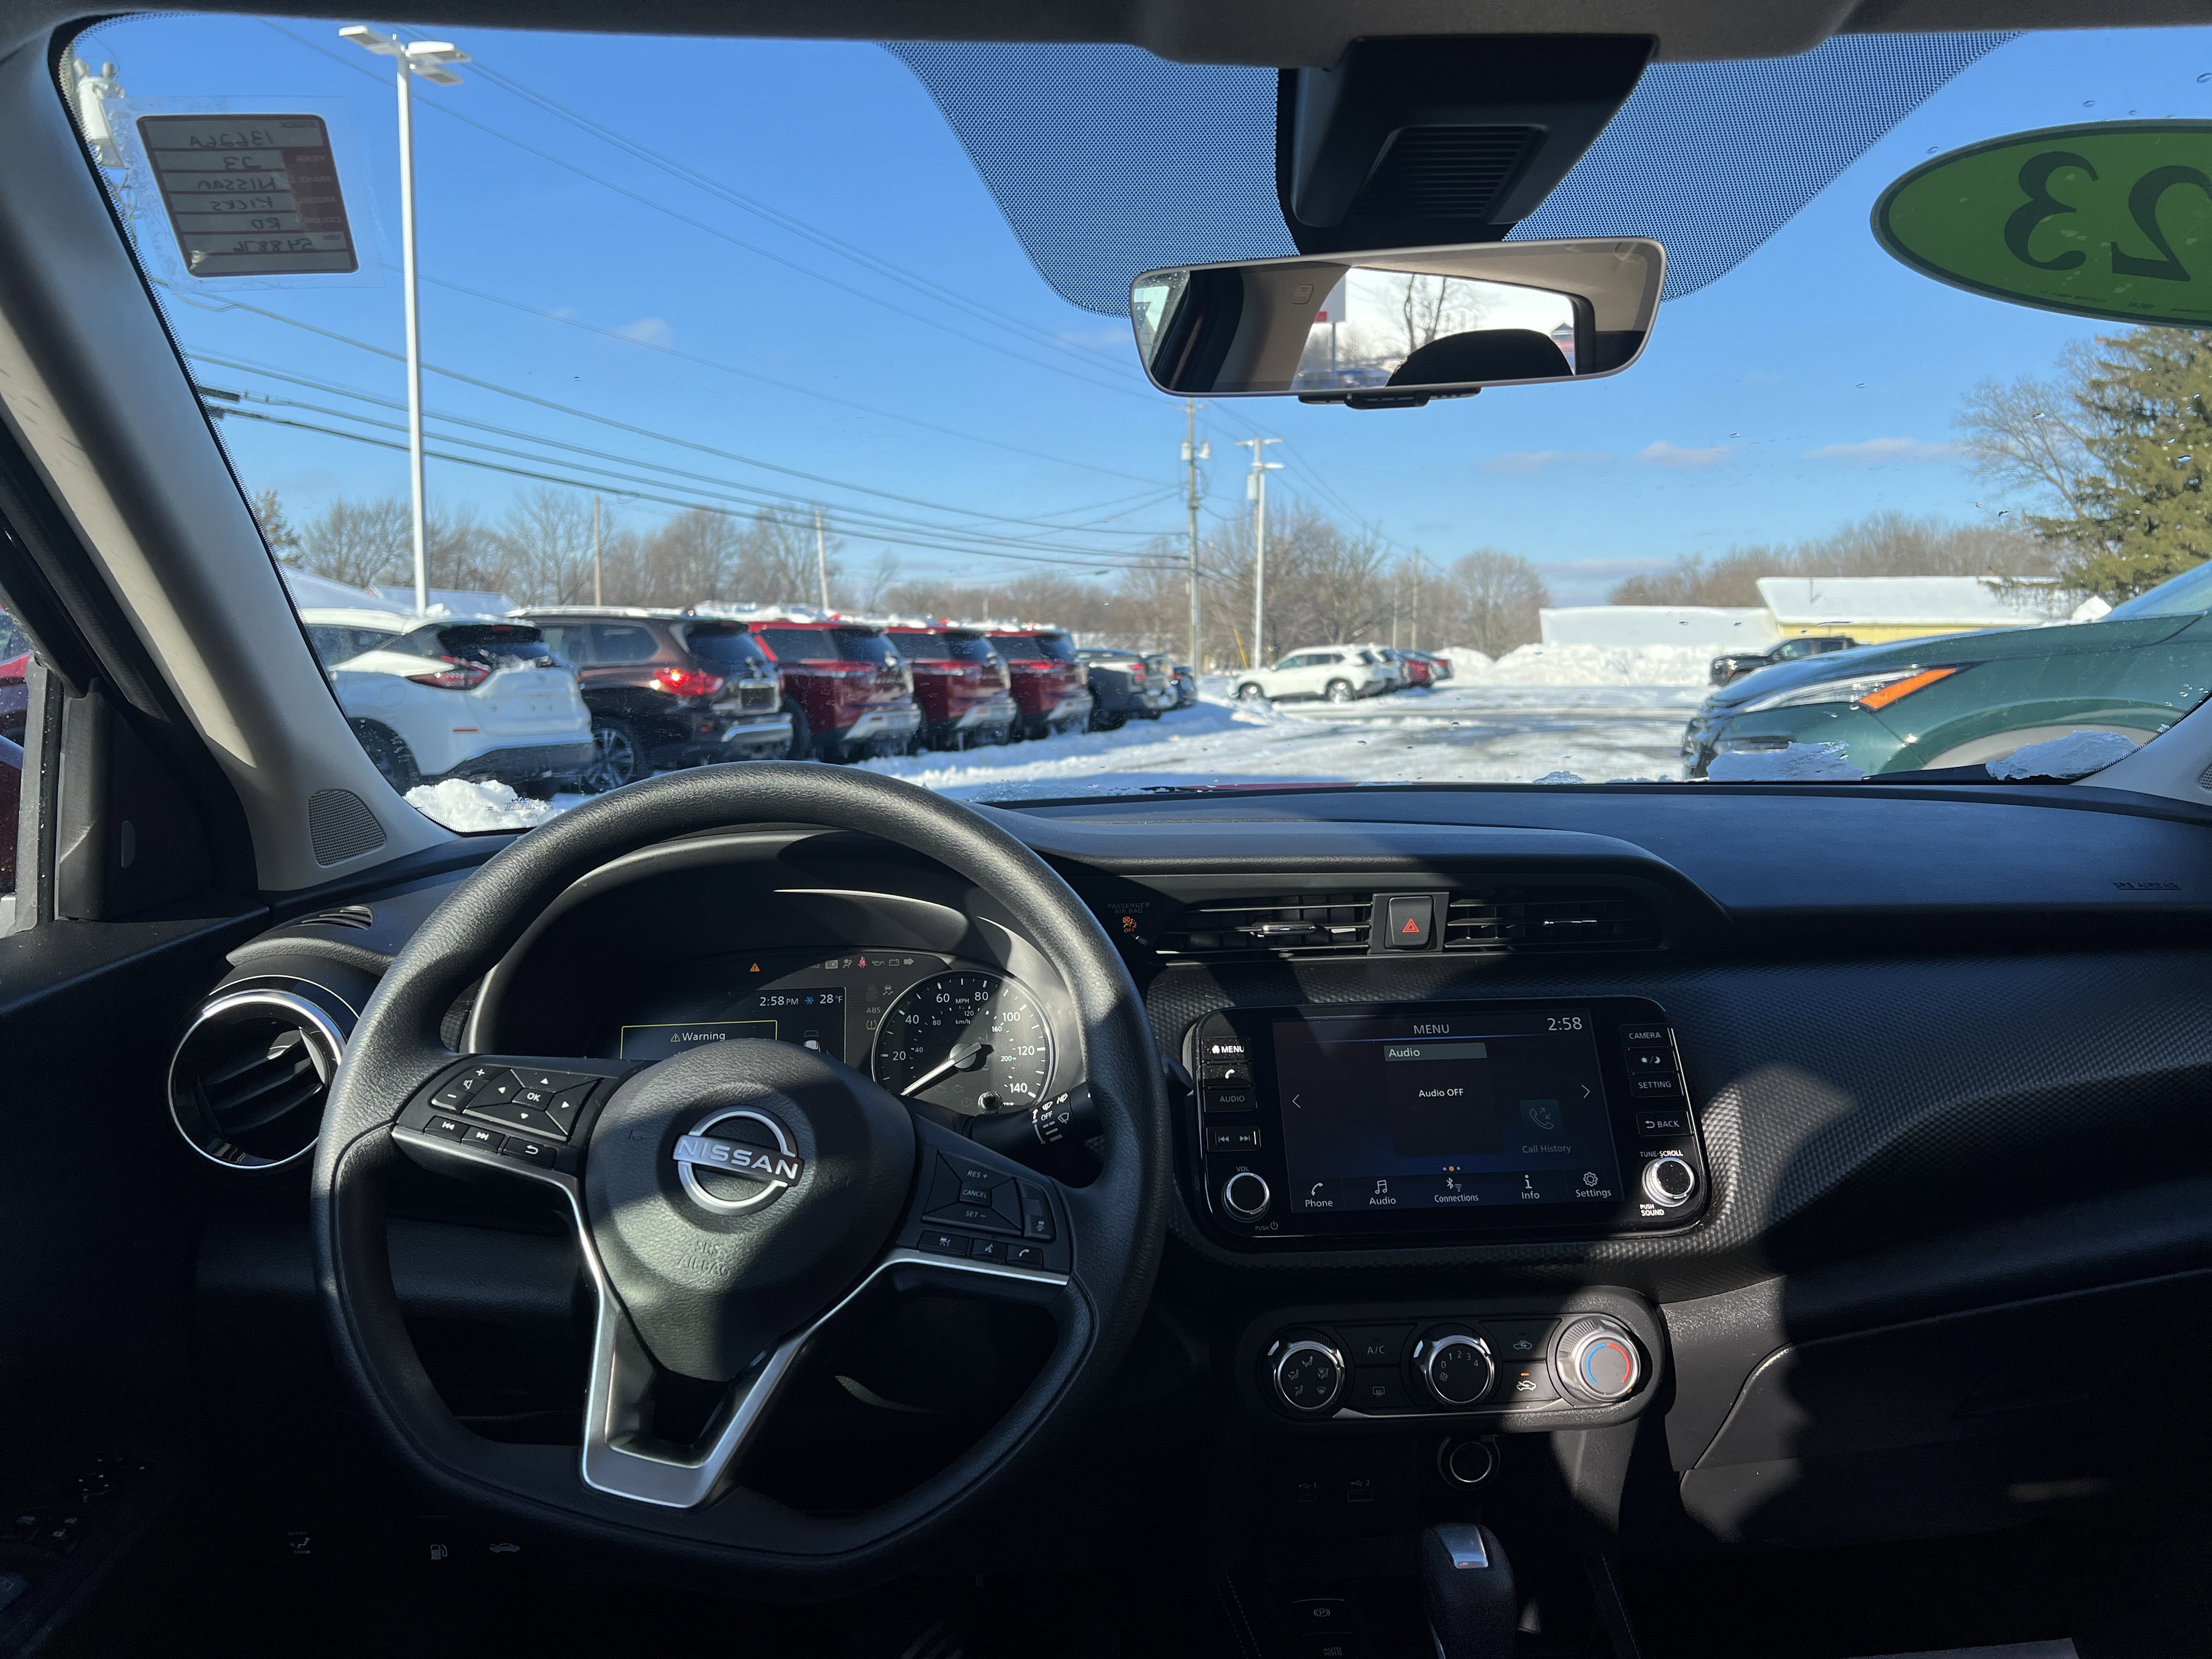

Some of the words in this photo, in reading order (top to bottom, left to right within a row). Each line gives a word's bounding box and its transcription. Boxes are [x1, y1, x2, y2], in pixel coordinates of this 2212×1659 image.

[936, 993, 950, 1003] 60
[974, 991, 989, 1001] 80
[759, 996, 785, 1007] 2:58
[905, 1015, 919, 1025] 40
[1002, 1012, 1020, 1022] 100
[1414, 1024, 1450, 1034] MENU
[1547, 1017, 1583, 1031] 2:58
[682, 1031, 725, 1041] Warning
[1017, 1046, 1035, 1056] 120
[1221, 1045, 1245, 1053] MENU
[1389, 1048, 1420, 1058] Audio
[893, 1051, 906, 1061] 20
[1009, 1082, 1028, 1093] 140
[1638, 1081, 1672, 1089] SETTING
[527, 1092, 540, 1102] OK
[1418, 1089, 1445, 1097] Audio
[1041, 1110, 1053, 1121] OFF
[1522, 1145, 1538, 1153] Call
[1541, 1144, 1571, 1154] History
[677, 1138, 798, 1180] NISSAN
[962, 1189, 988, 1199] CANCEL
[1434, 1193, 1479, 1203] Connections
[1521, 1191, 1540, 1200] Info
[1575, 1188, 1612, 1199] Settings
[1305, 1199, 1333, 1207] Phone
[1369, 1197, 1396, 1205] Audio
[1367, 1346, 1385, 1355] A/C
[1449, 1352, 1452, 1361] 1
[1466, 1352, 1471, 1361] 3
